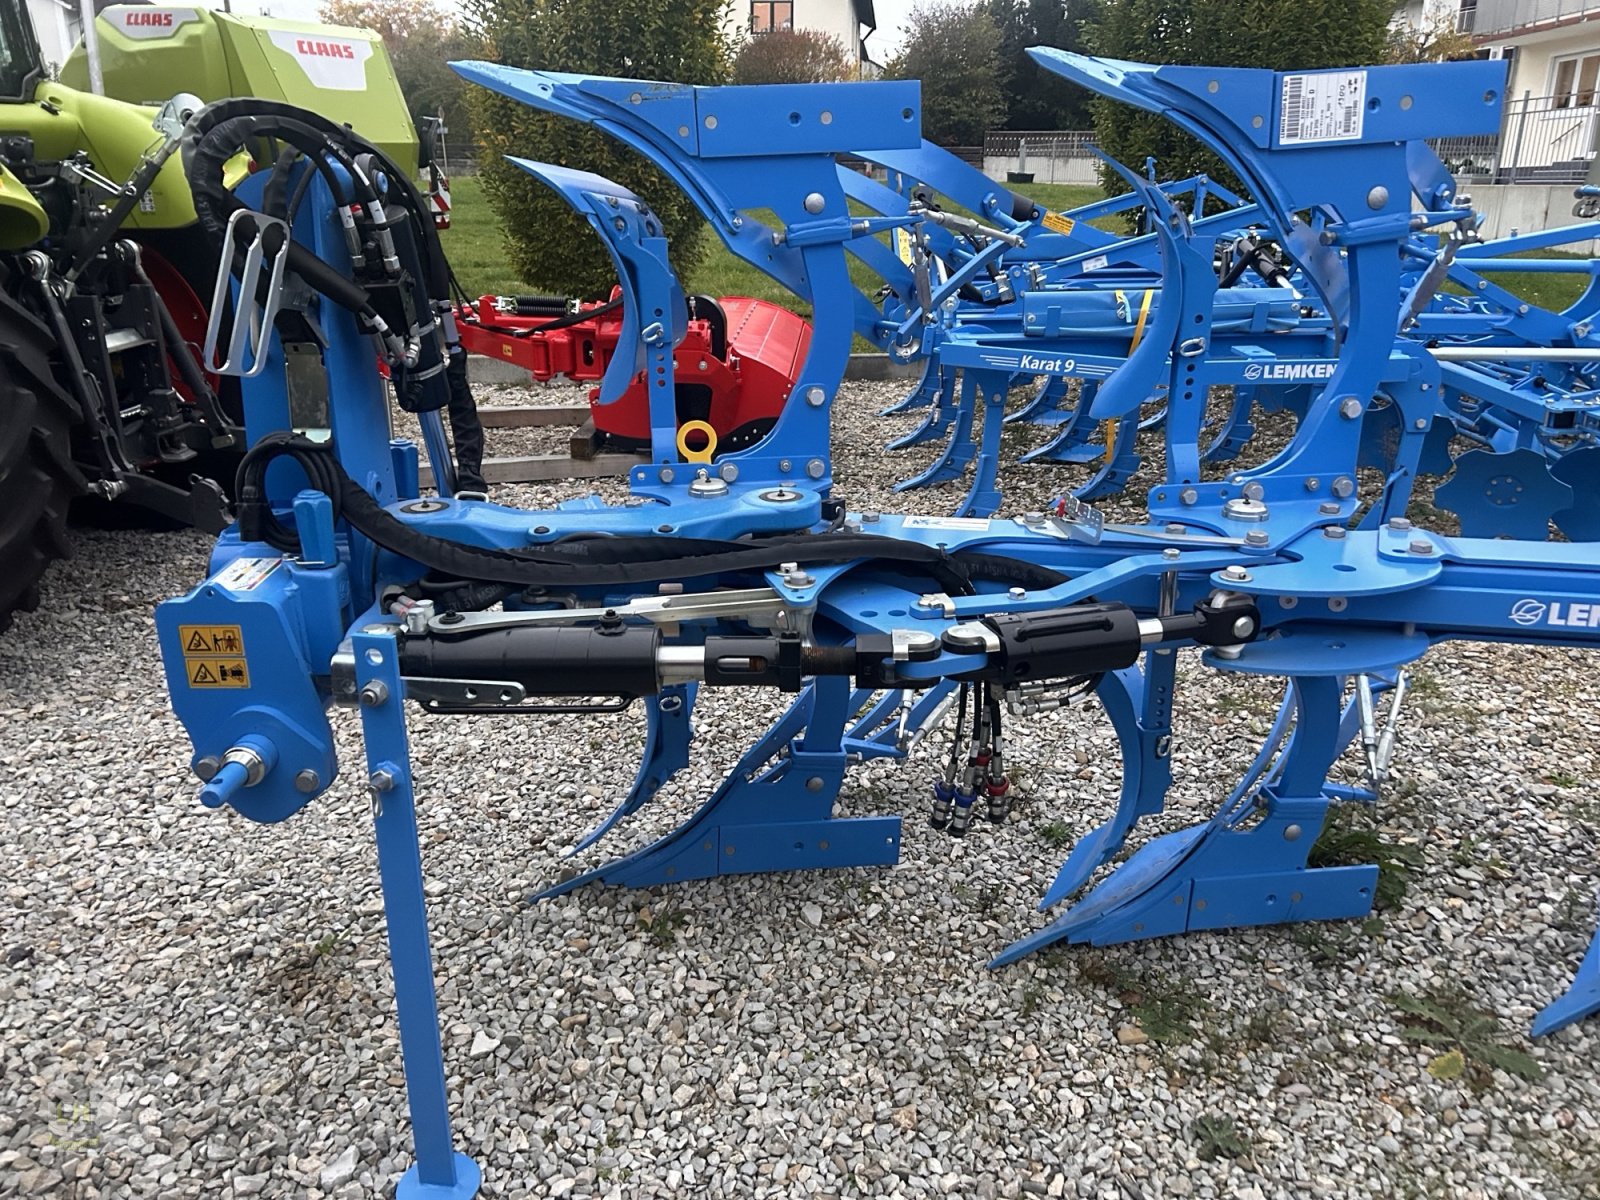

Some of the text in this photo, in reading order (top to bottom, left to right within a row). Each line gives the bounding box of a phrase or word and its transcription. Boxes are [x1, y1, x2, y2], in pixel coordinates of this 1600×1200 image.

[126, 13, 172, 26] CLAAS
[296, 40, 354, 59] CLAAS
[1020, 354, 1075, 373] Karat 9
